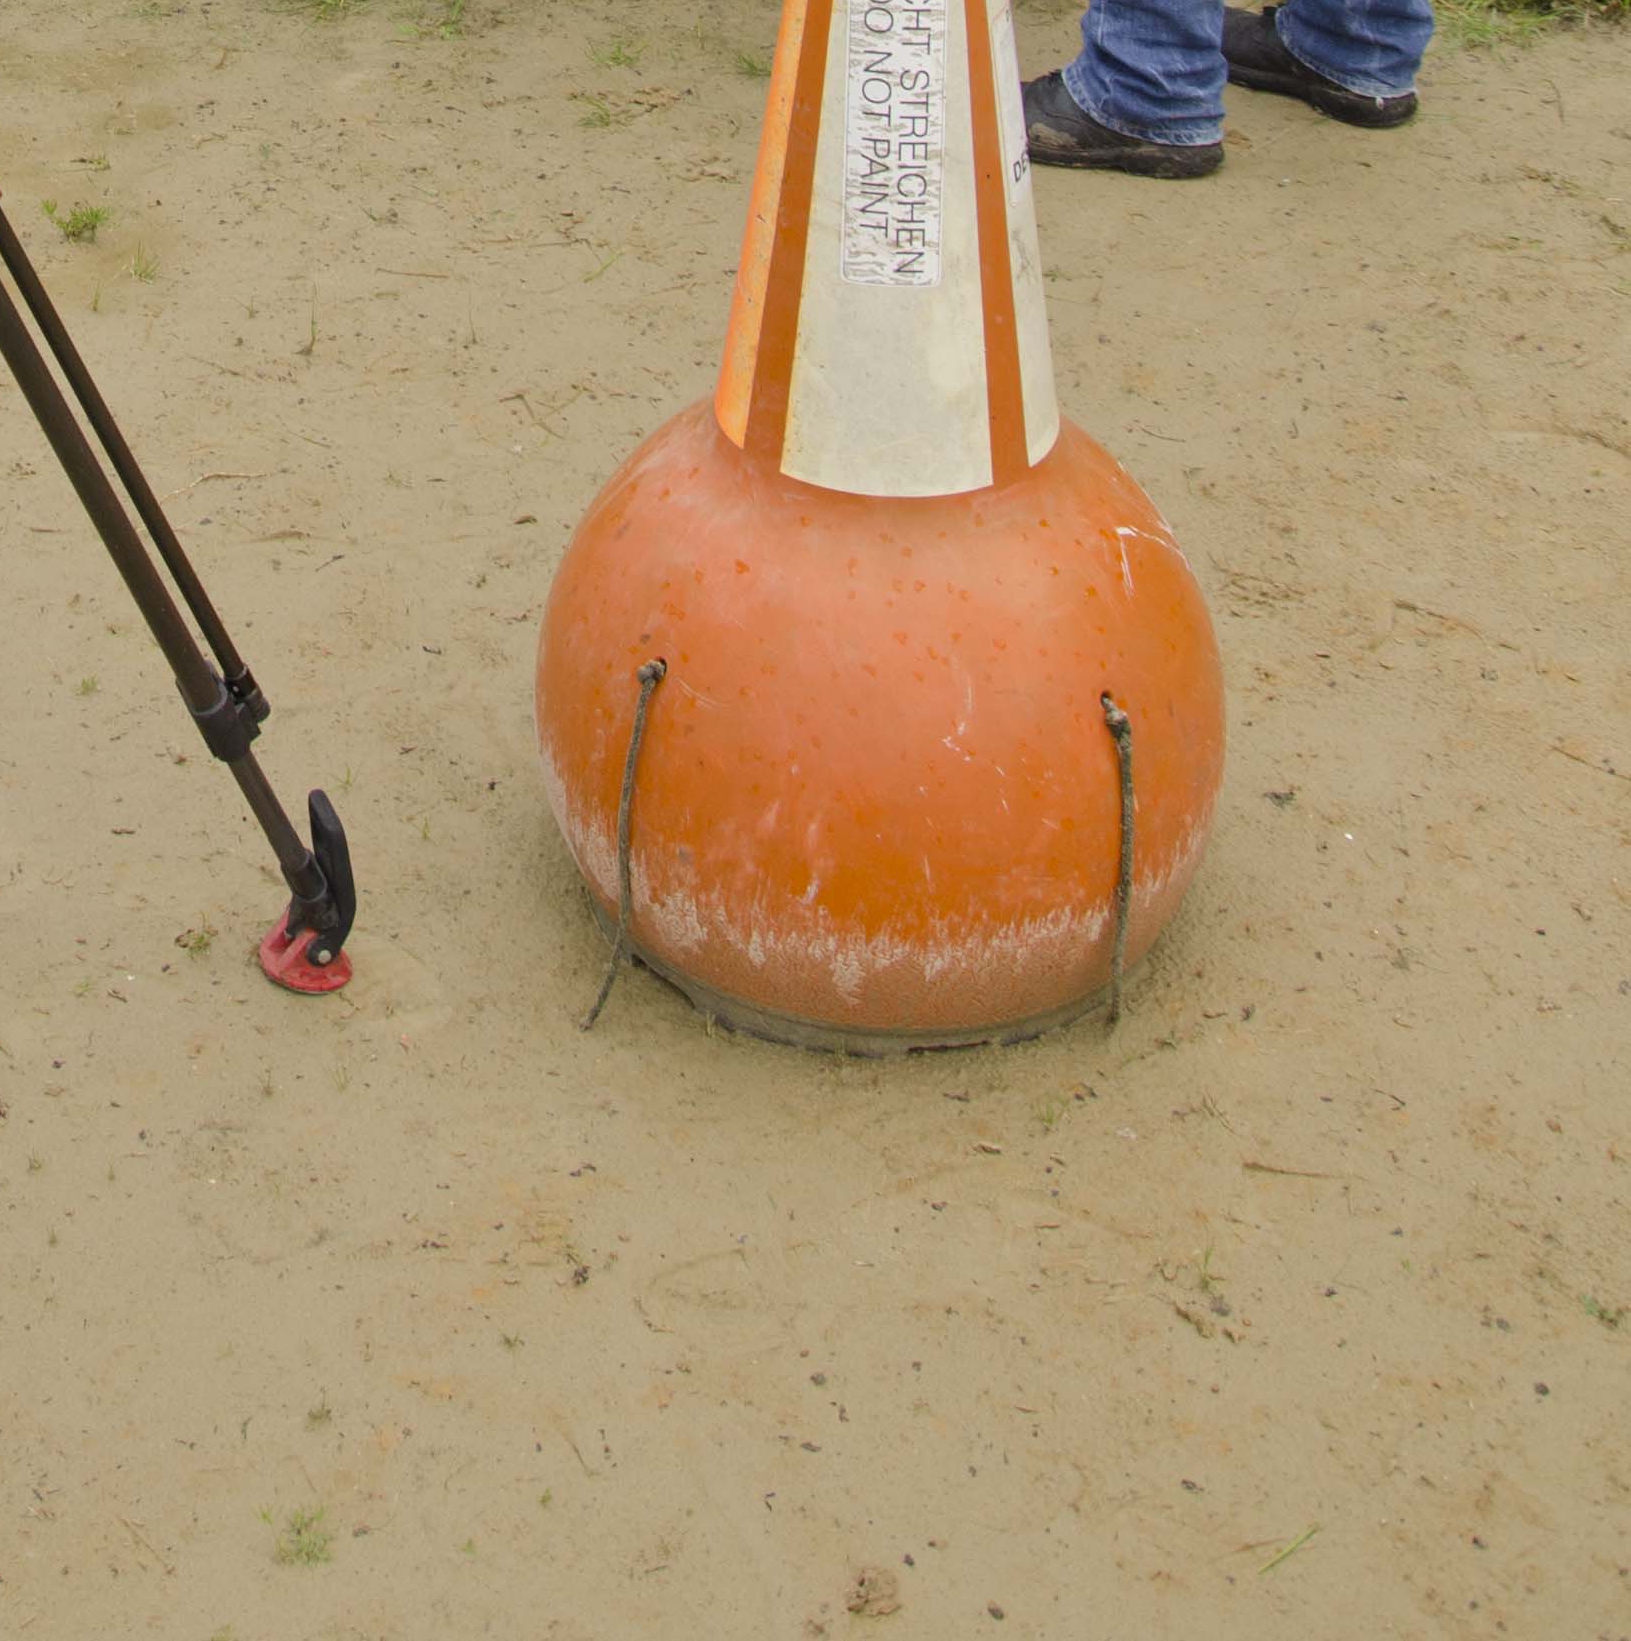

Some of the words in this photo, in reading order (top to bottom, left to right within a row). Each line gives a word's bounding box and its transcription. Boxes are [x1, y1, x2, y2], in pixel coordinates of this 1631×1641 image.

[862, 50, 893, 127] NOT
[859, 137, 891, 239] PAINT
[894, 69, 930, 274] STREICHEN
